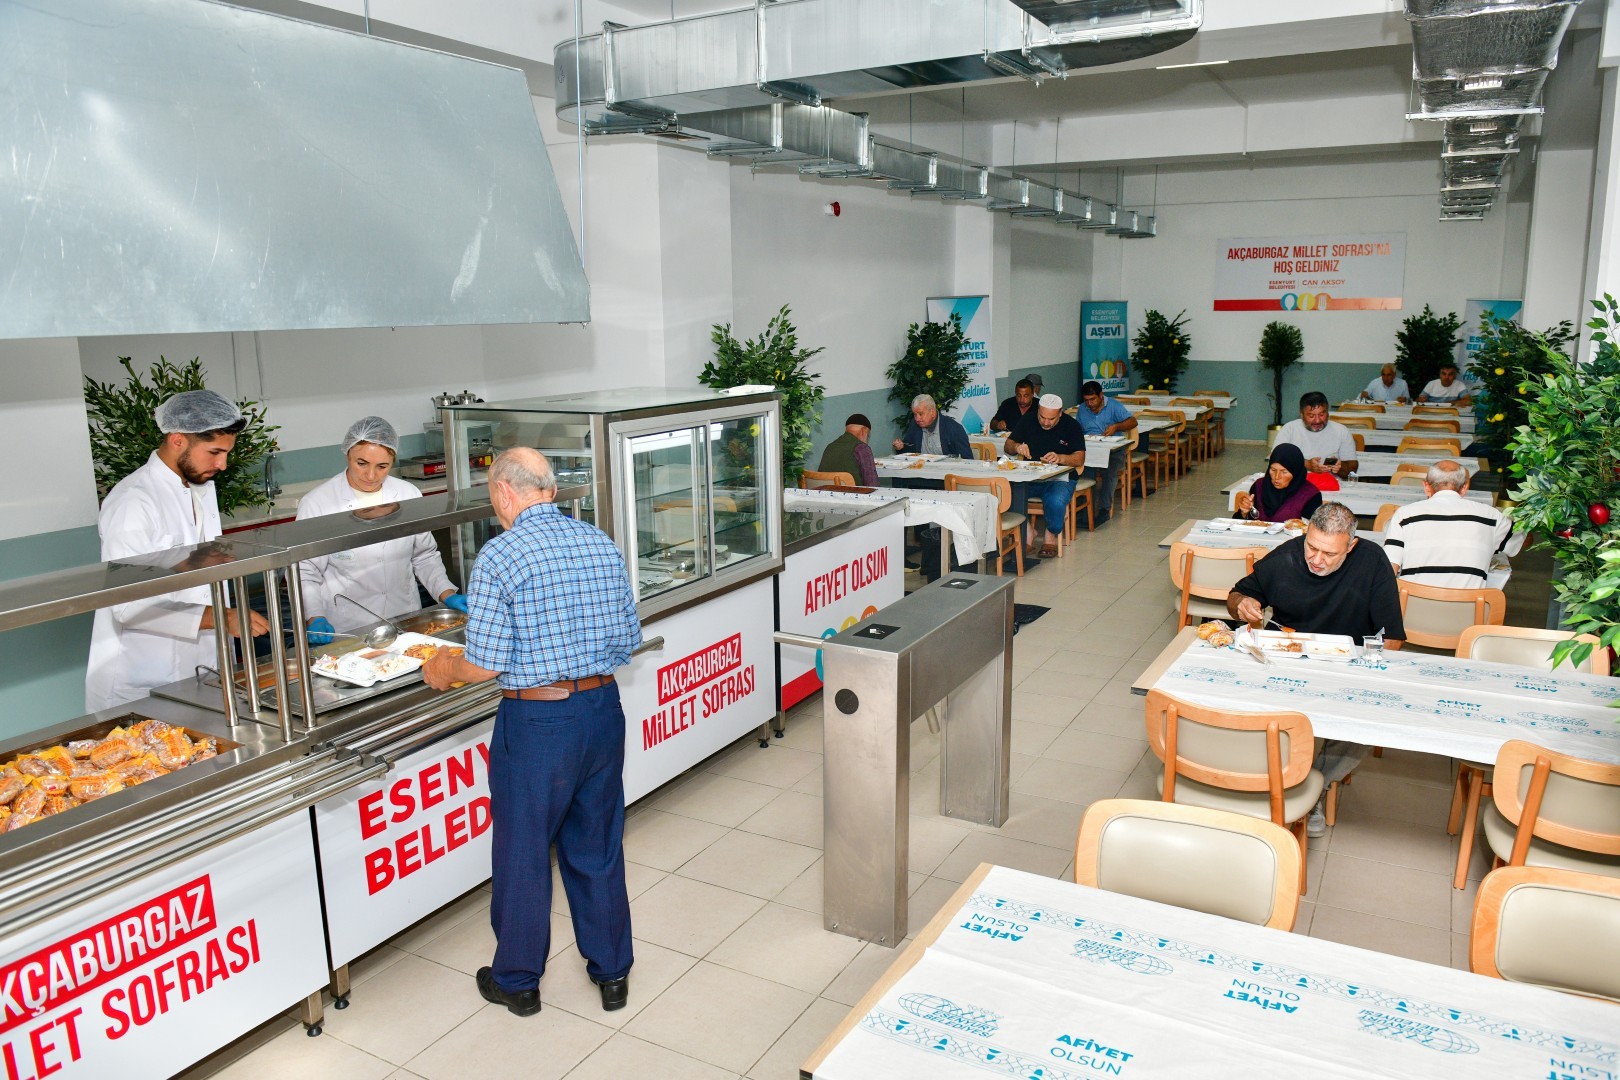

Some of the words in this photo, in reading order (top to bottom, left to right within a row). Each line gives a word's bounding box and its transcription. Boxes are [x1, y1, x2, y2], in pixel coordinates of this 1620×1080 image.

[1227, 246, 1289, 262] AKÇABURGAZ
[1273, 261, 1293, 275] HOŞ
[804, 563, 849, 617] AFİYET
[851, 545, 888, 592] OLSUN
[660, 645, 740, 695] AKÇABURGAZ
[642, 694, 697, 751] MİLLET
[702, 664, 755, 719] SOFRASI
[971, 913, 1029, 933] OLSUN
[102, 918, 261, 1040] SOFRASI
[1232, 978, 1301, 1002] OLSUN
[1050, 1046, 1123, 1076] OLSUN
[1055, 1033, 1134, 1062] AFİYET
